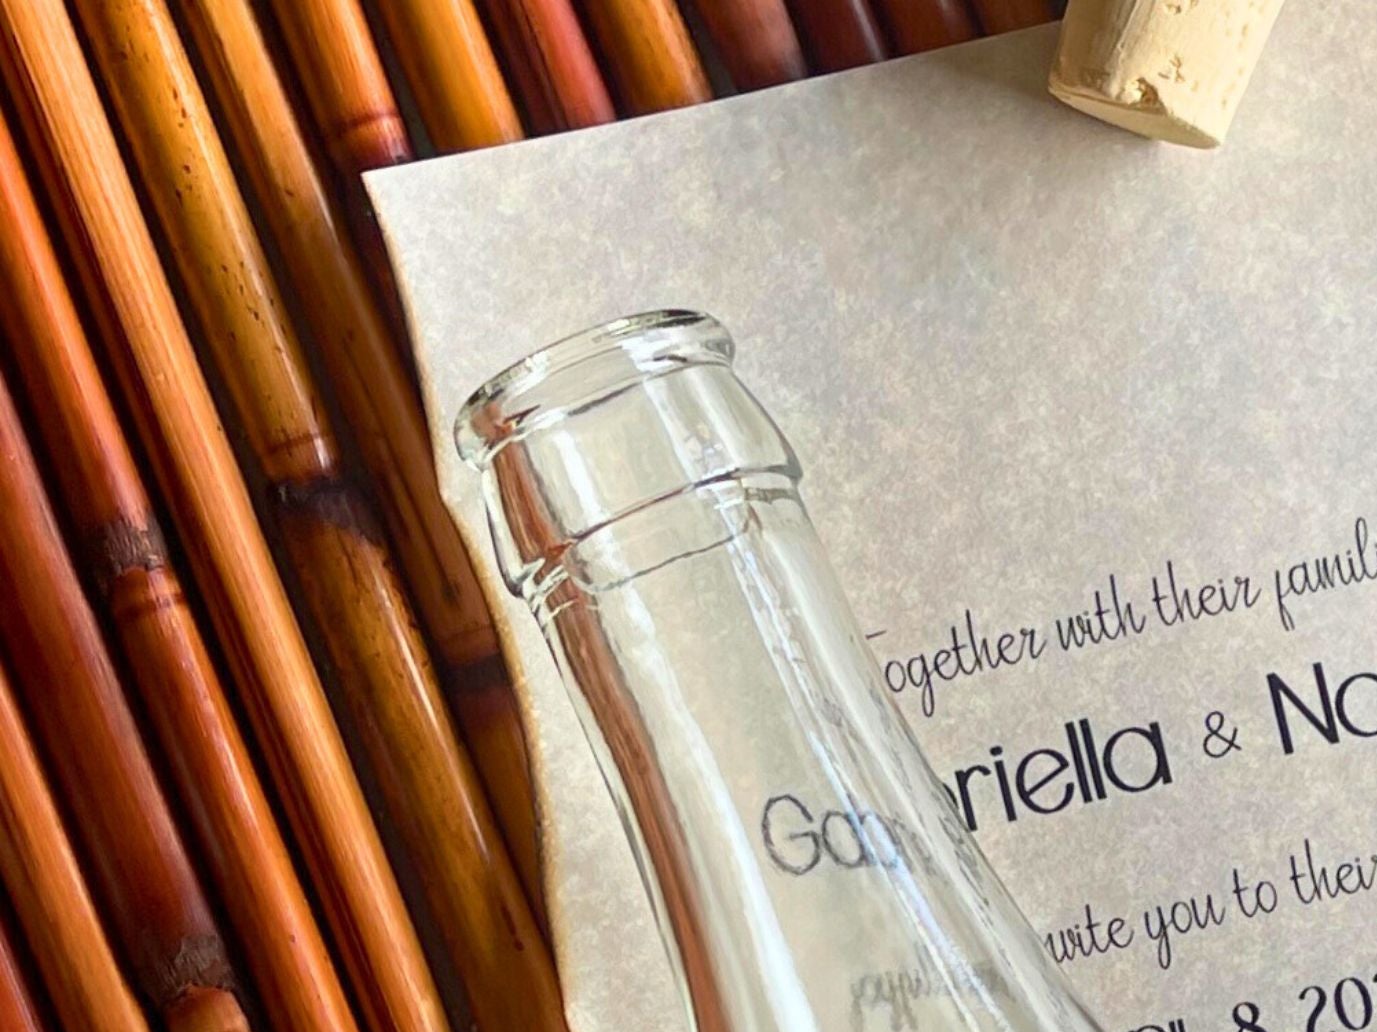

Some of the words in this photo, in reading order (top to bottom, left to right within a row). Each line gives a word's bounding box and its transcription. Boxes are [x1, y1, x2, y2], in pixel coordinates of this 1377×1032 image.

[866, 609, 1047, 718] ogether
[1056, 573, 1147, 651] with
[1152, 560, 1262, 630] their
[1203, 711, 1242, 758] &
[1143, 890, 1226, 970] you
[1232, 868, 1278, 920] to
